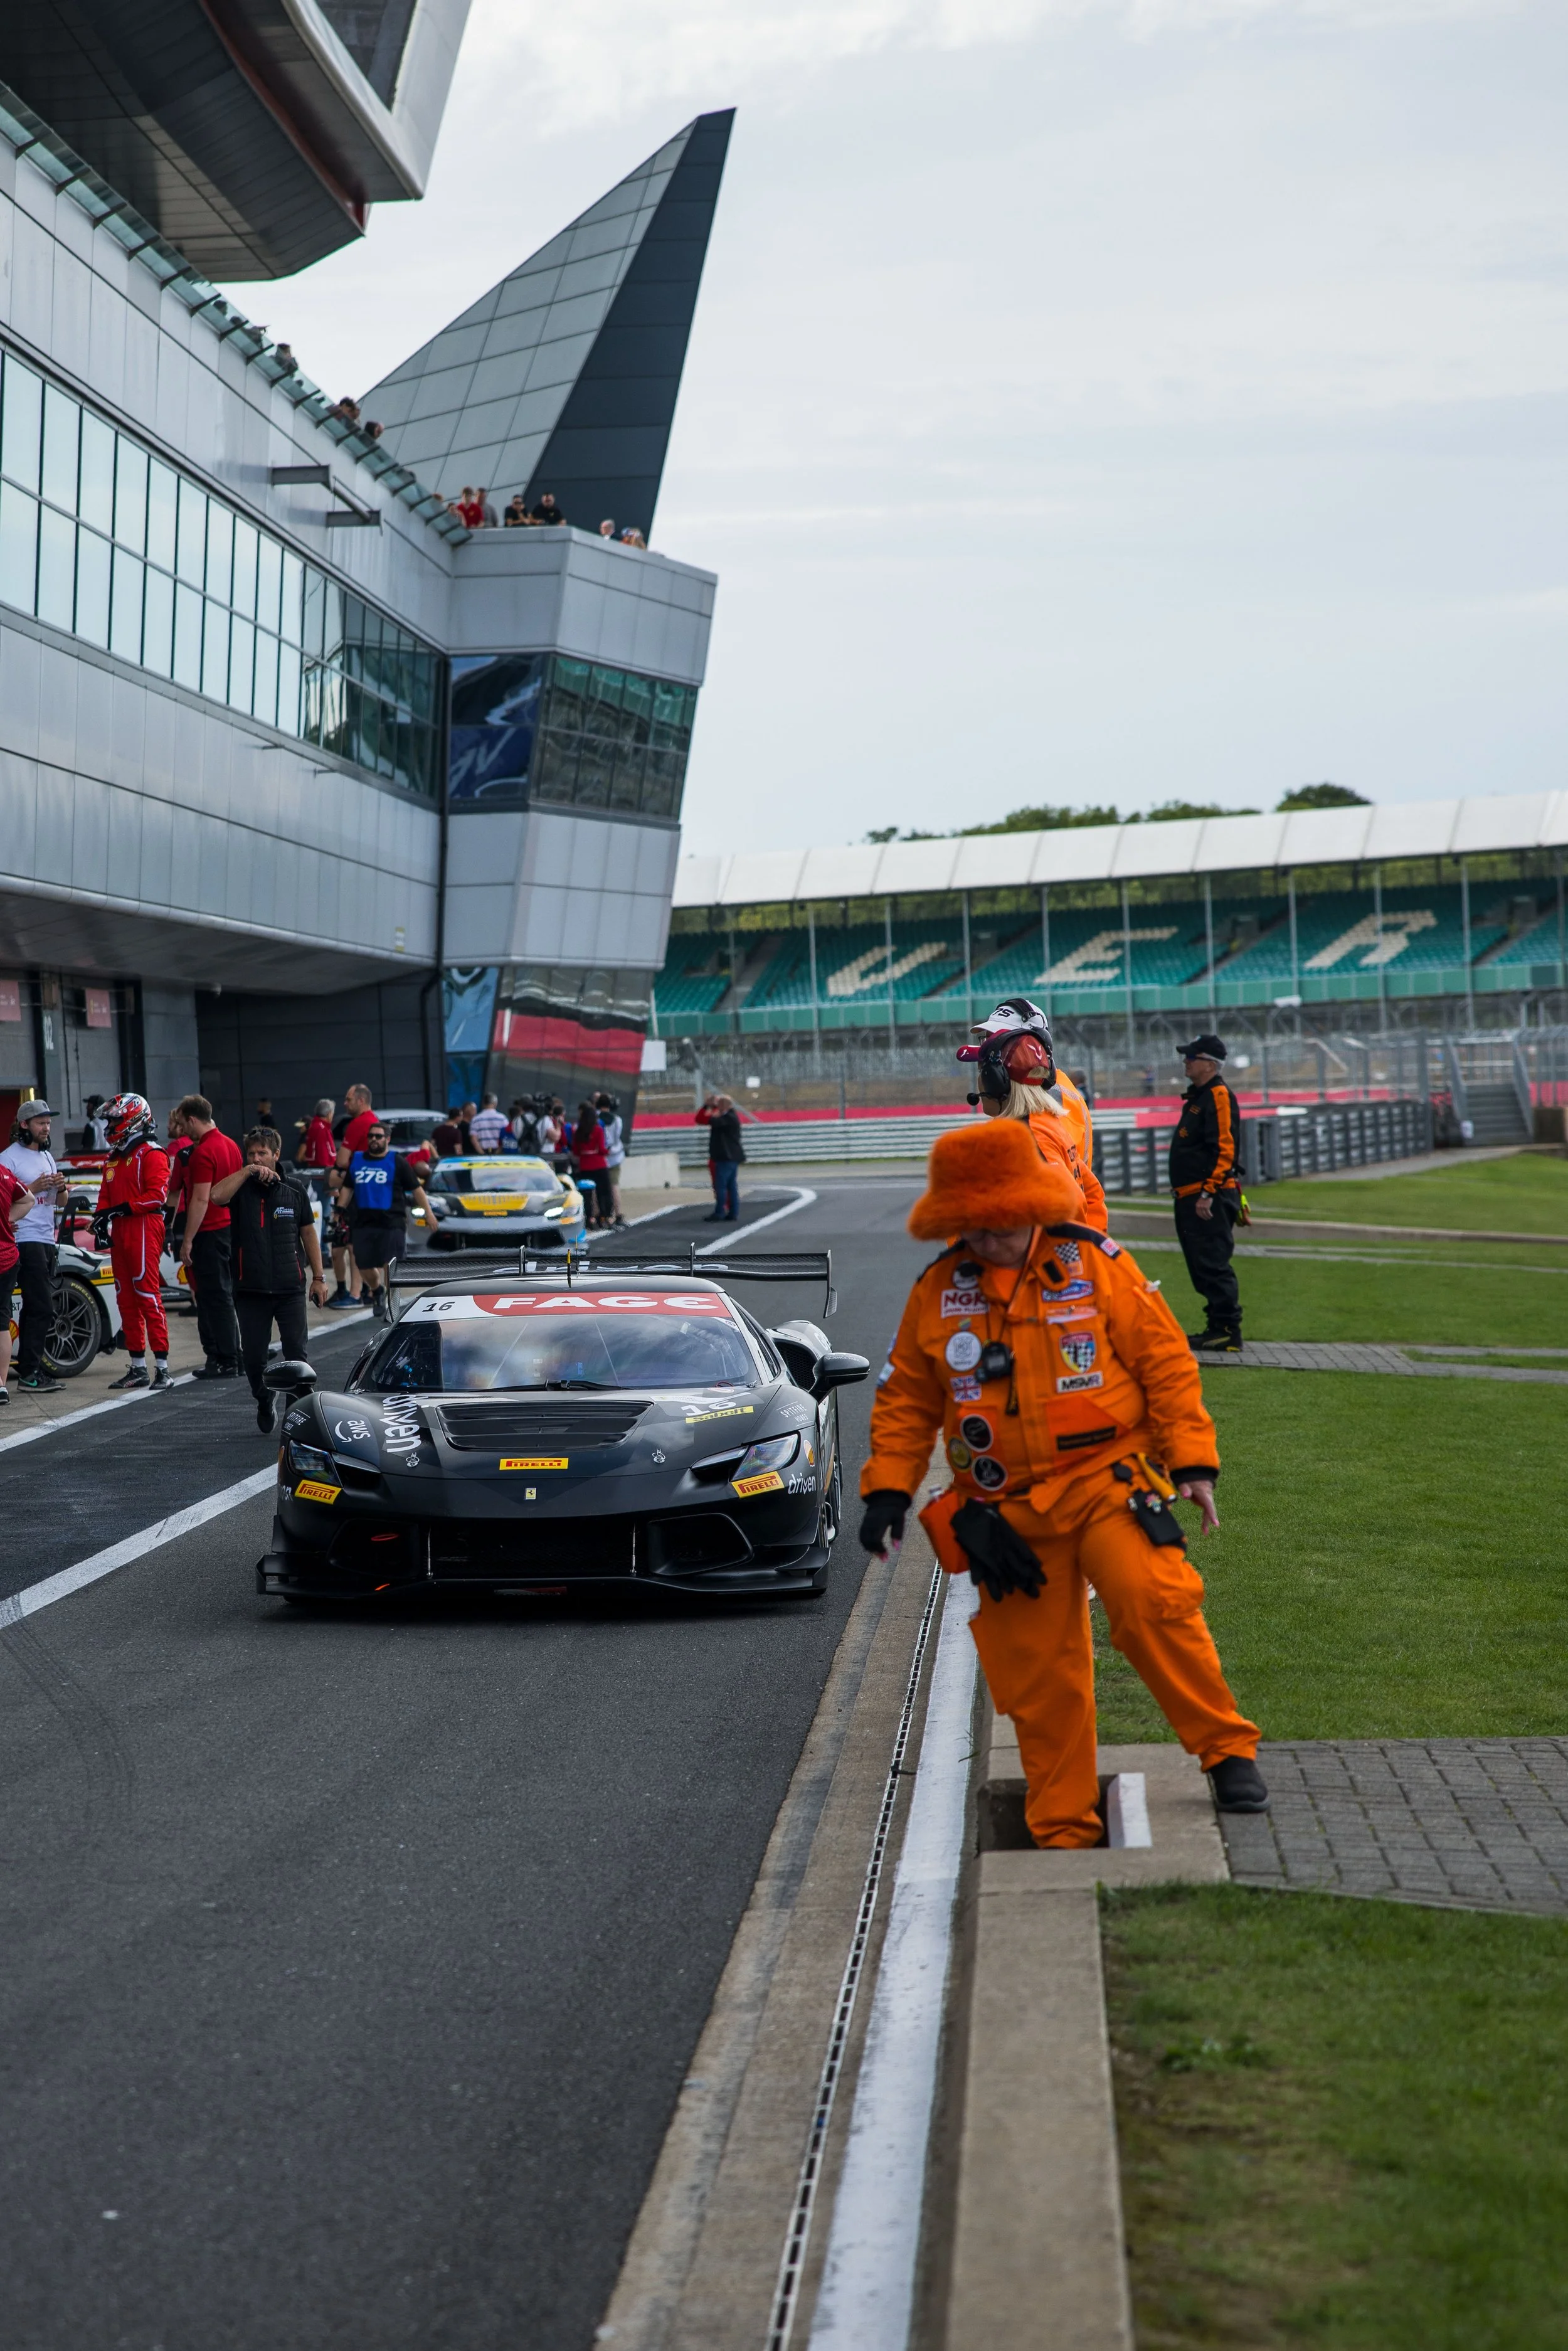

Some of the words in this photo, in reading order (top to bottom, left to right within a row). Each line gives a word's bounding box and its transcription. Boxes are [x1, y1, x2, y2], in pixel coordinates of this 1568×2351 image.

[354, 1170, 388, 1184] 278
[422, 1302, 455, 1312] 16
[494, 1296, 720, 1310] FAGE
[944, 1292, 987, 1308] NGK
[681, 1400, 736, 1416] 16
[693, 1408, 748, 1422] Sabelt
[780, 1404, 807, 1418] SPITFIRE
[287, 1411, 307, 1425] SPITFIRE
[379, 1394, 428, 1453] driven
[347, 1420, 371, 1439] aws
[299, 1483, 336, 1500] PIRELLI
[738, 1475, 779, 1494] PIRELLI
[788, 1473, 816, 1494] driven
